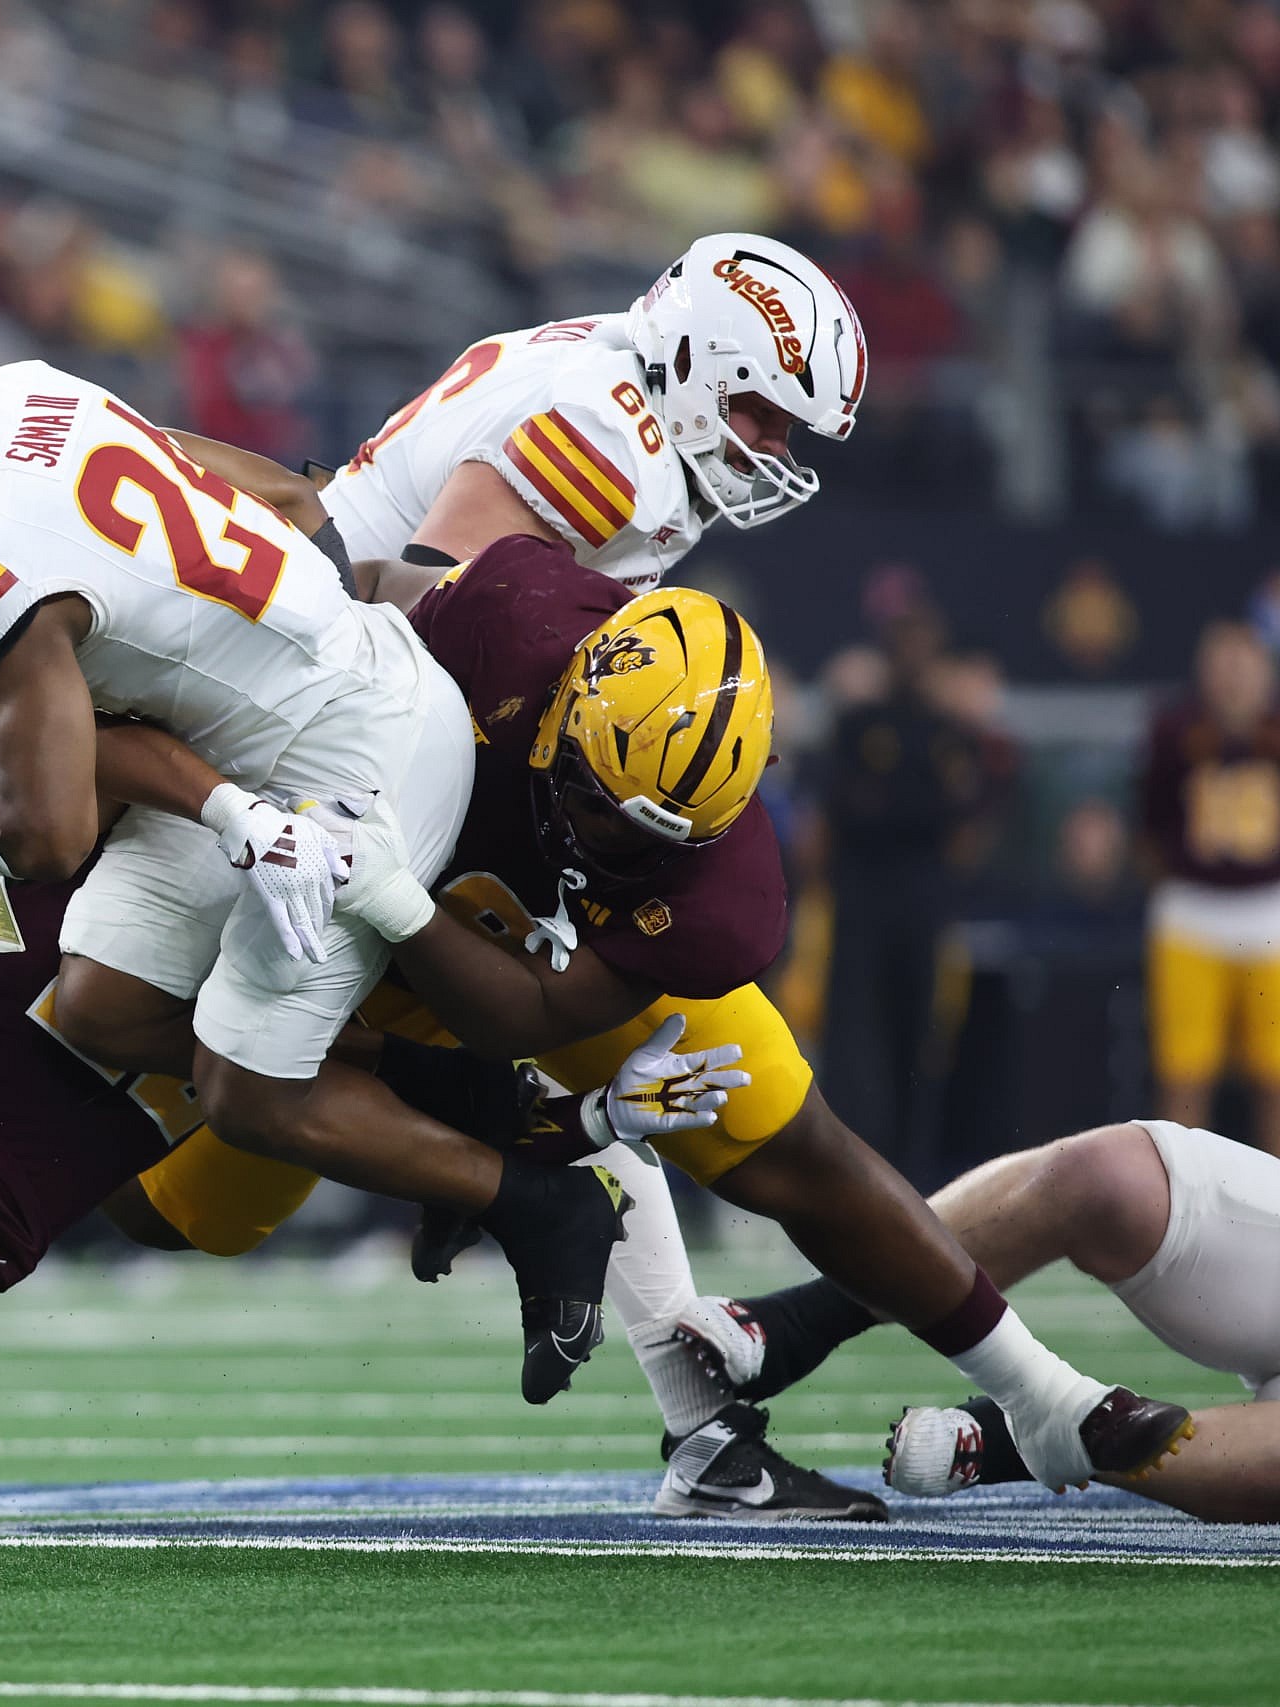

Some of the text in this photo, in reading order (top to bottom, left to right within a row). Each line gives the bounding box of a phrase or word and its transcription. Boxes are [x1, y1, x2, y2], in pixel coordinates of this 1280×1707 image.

[713, 259, 806, 375] Cyclones
[5, 394, 80, 468] SAMA III
[611, 381, 665, 456] 66
[718, 381, 728, 425] CYCLON
[639, 806, 658, 821] SUN
